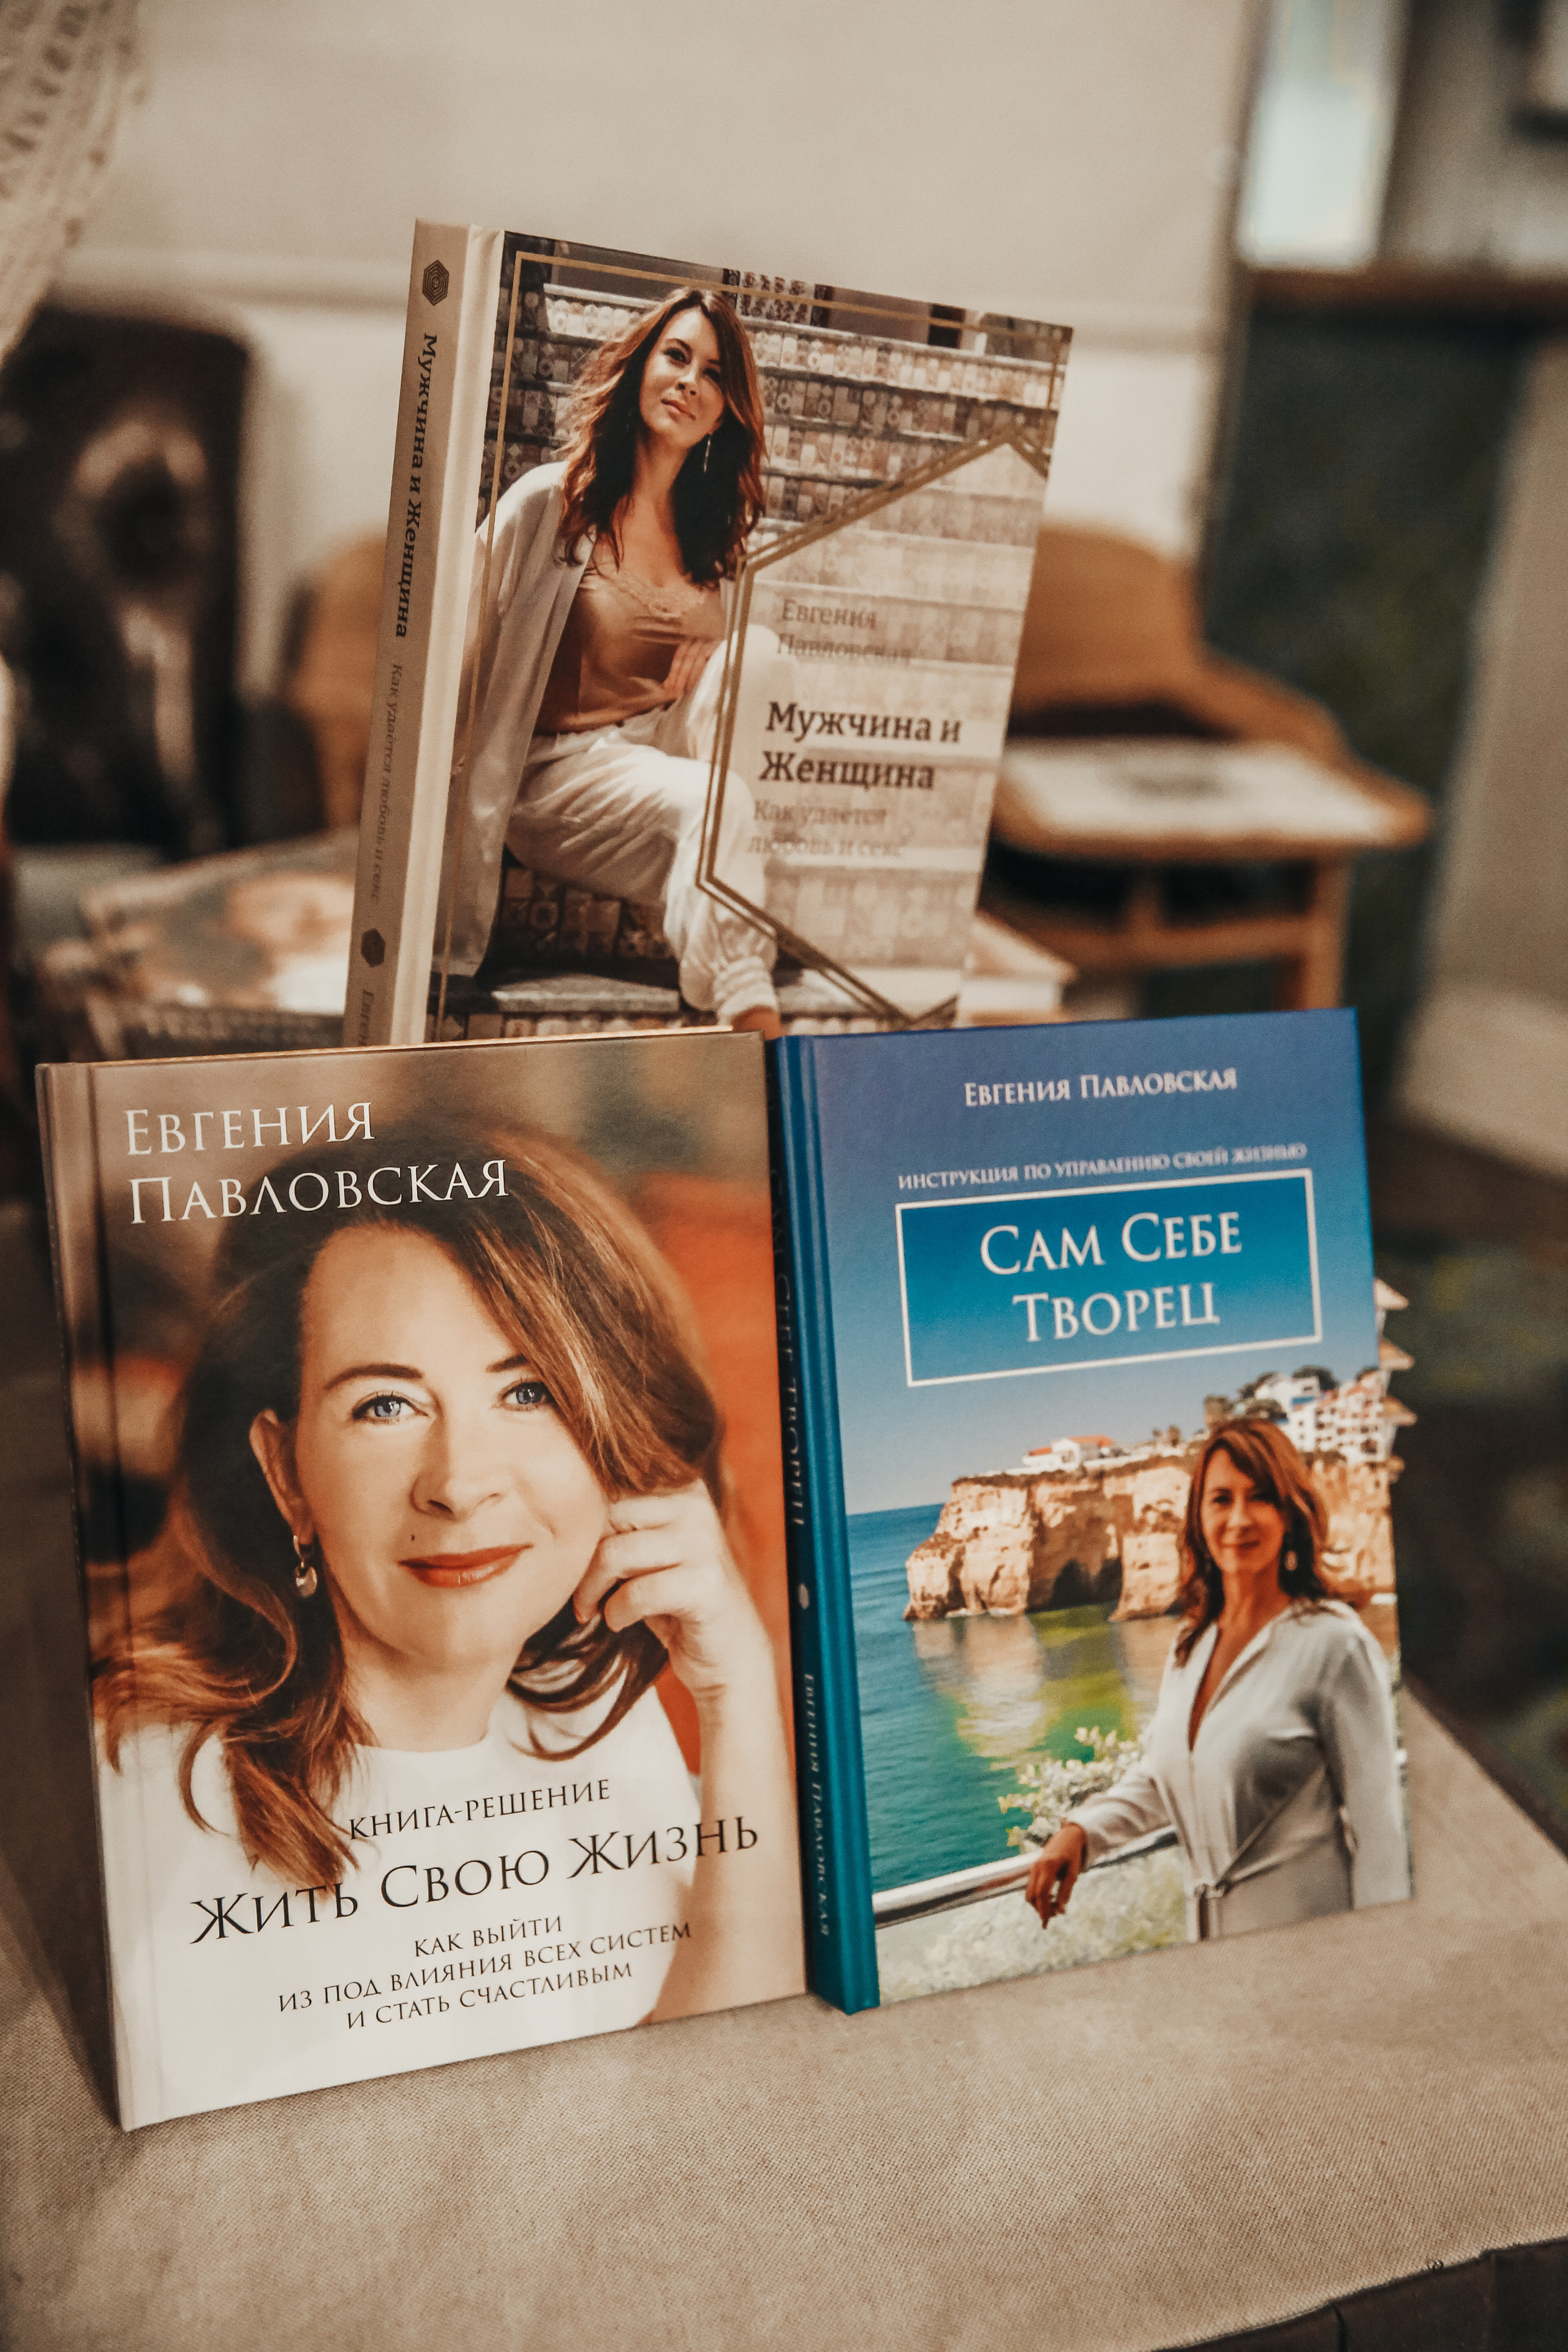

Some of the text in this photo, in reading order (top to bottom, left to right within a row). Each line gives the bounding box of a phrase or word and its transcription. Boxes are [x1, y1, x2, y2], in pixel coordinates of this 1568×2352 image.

[395, 333, 437, 638] Мужчина и Женщина
[782, 598, 877, 630] Евгения
[765, 701, 963, 743] Мужчина и
[758, 751, 935, 790] Женщина
[964, 1068, 1237, 1107] ЕВГЕНИЯ ПАВЛОВСКАЯ
[126, 1102, 375, 1155] ЕВГЕНИЯ
[128, 1159, 509, 1224] ПАВЛОВСКАЯ
[898, 1165, 1019, 1190] ИНСТРУКЦИЯ
[1024, 1163, 1052, 1180] ПО
[980, 1212, 1243, 1276] САМ СЕБЕ
[1012, 1283, 1221, 1343] ТВОРЕЦ
[349, 1778, 611, 1840] КНИГА-РЕШЕНИЕ
[189, 1817, 759, 1944] ЖИТЬ СВОЮ ЖИЗНЬ
[278, 1921, 692, 2012] ИЗ ПОД ВЛИЯНИЯ ВСЕХ СИСТЕМ
[414, 1915, 563, 1958] КАК ВЫЙТИ
[347, 1962, 633, 2030] И СТАТЬ СЧАСТЛИВЫМ
